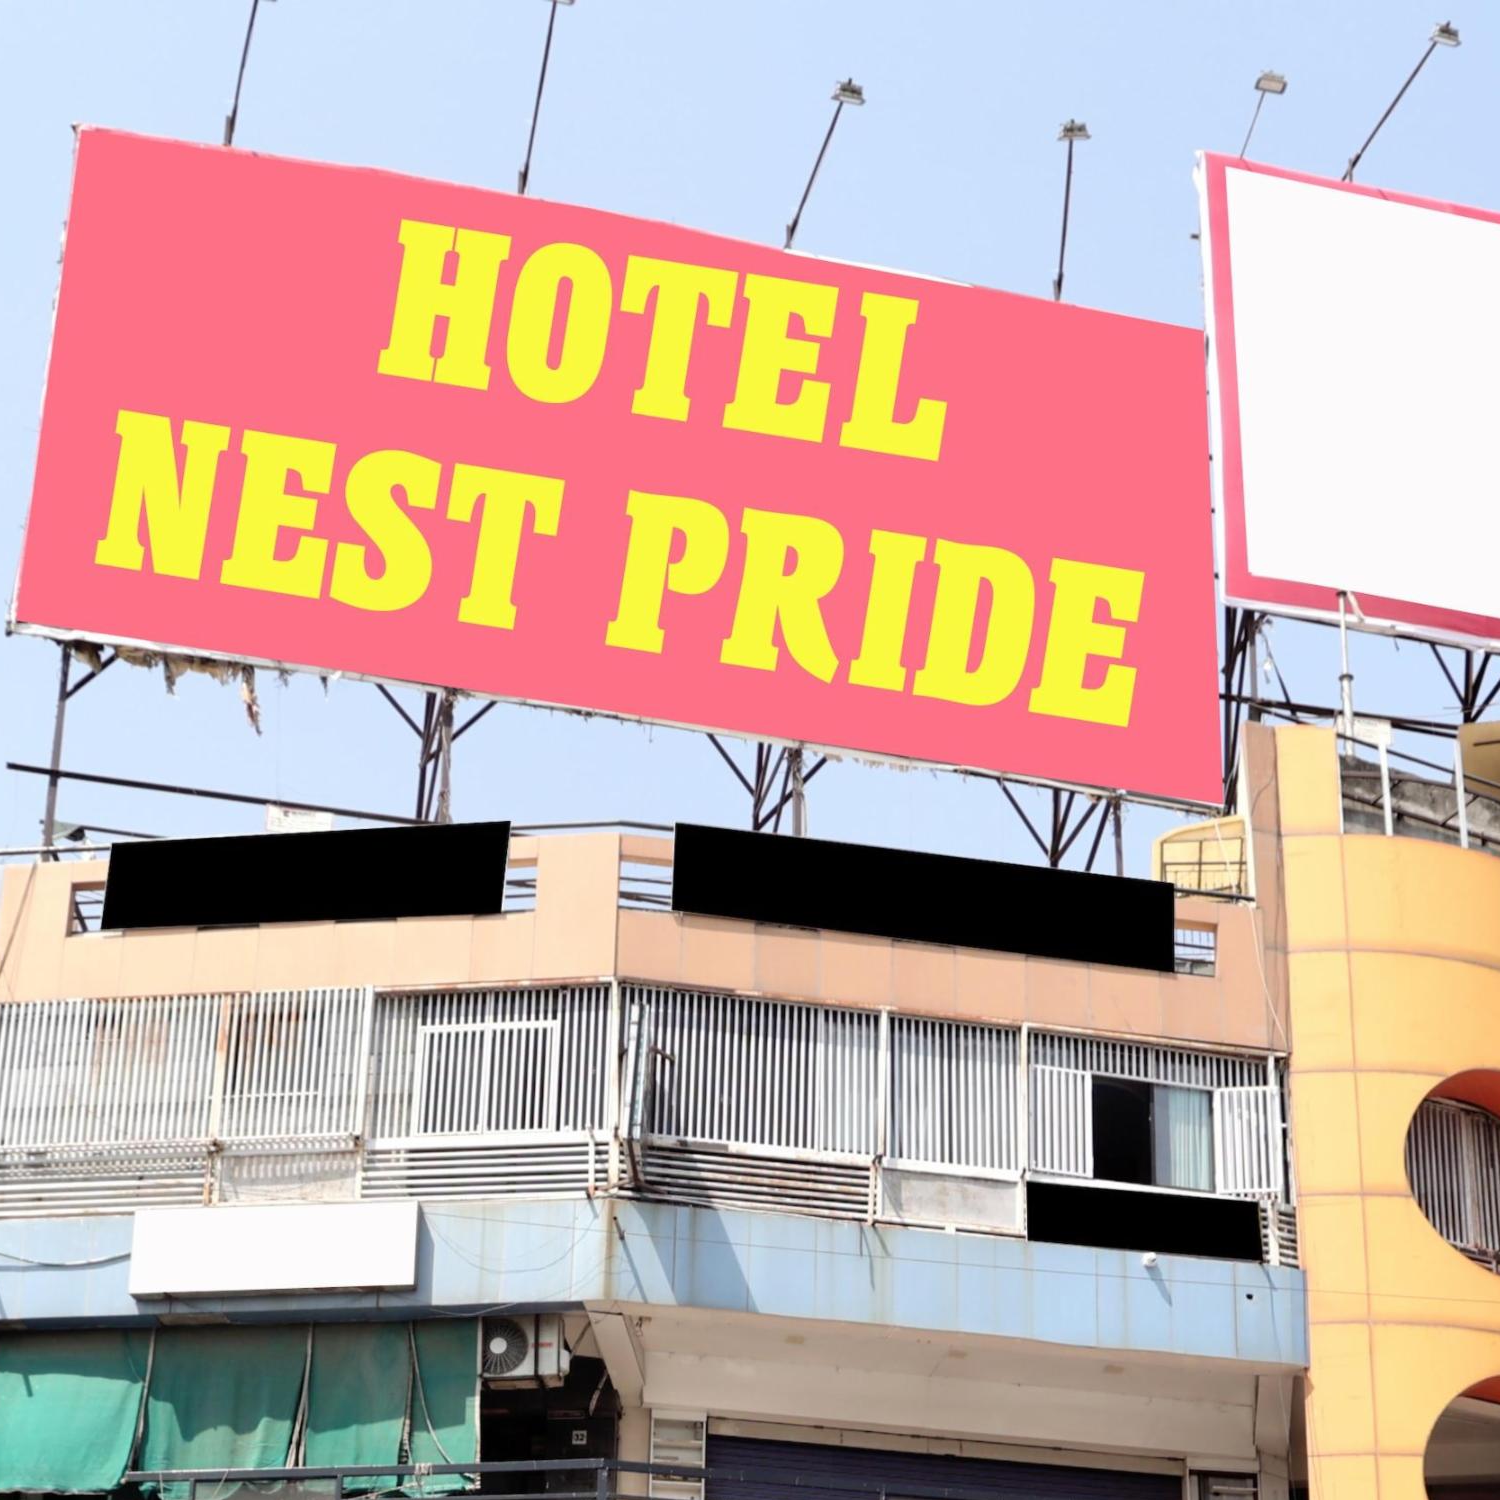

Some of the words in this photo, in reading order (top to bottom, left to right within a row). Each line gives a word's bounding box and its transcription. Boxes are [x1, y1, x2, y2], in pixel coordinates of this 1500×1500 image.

[377, 219, 948, 462] HOTEL
[94, 409, 566, 630] NEST
[605, 489, 1145, 728] PRIDE
